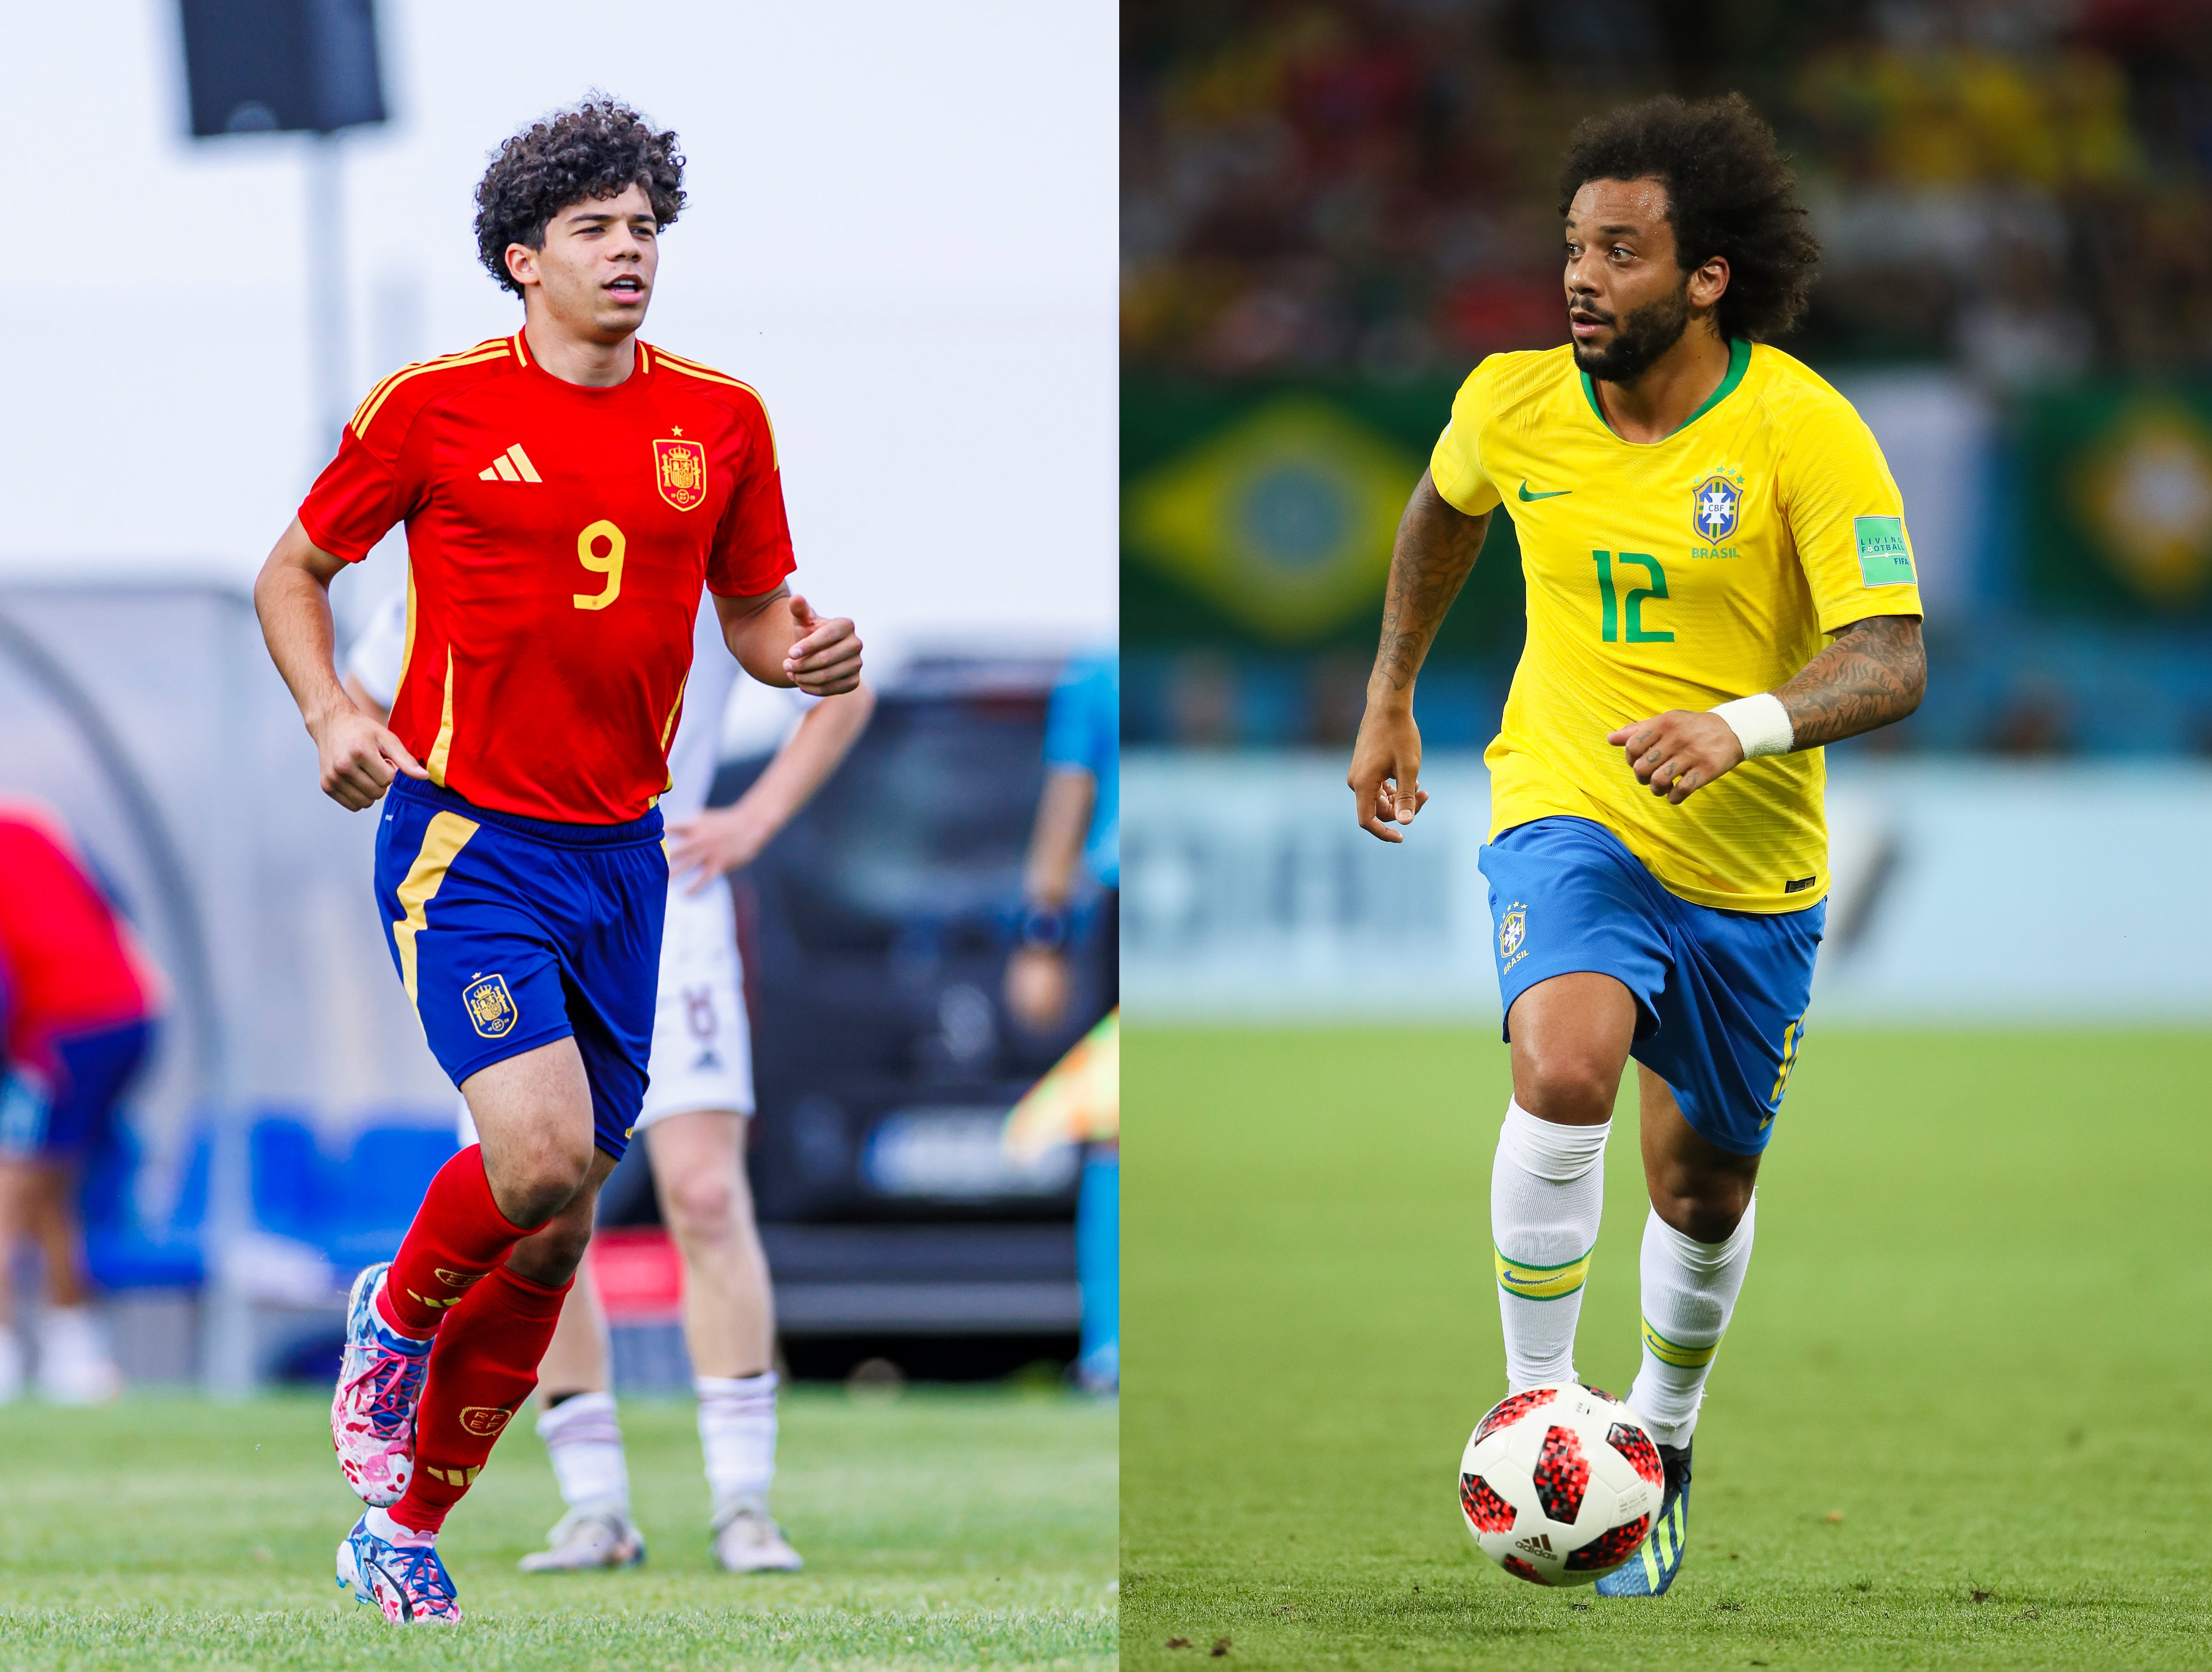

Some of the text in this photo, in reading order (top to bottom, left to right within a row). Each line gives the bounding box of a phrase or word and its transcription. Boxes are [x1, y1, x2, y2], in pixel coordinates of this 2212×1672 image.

[1861, 536, 1902, 545] LIVING
[1691, 547, 1740, 559] BRASIL
[573, 519, 626, 611] 9
[1592, 550, 1675, 643] 12
[1508, 929, 1517, 939] CBF
[1504, 949, 1530, 976] BRASIL
[1515, 1541, 1558, 1561] adidas
